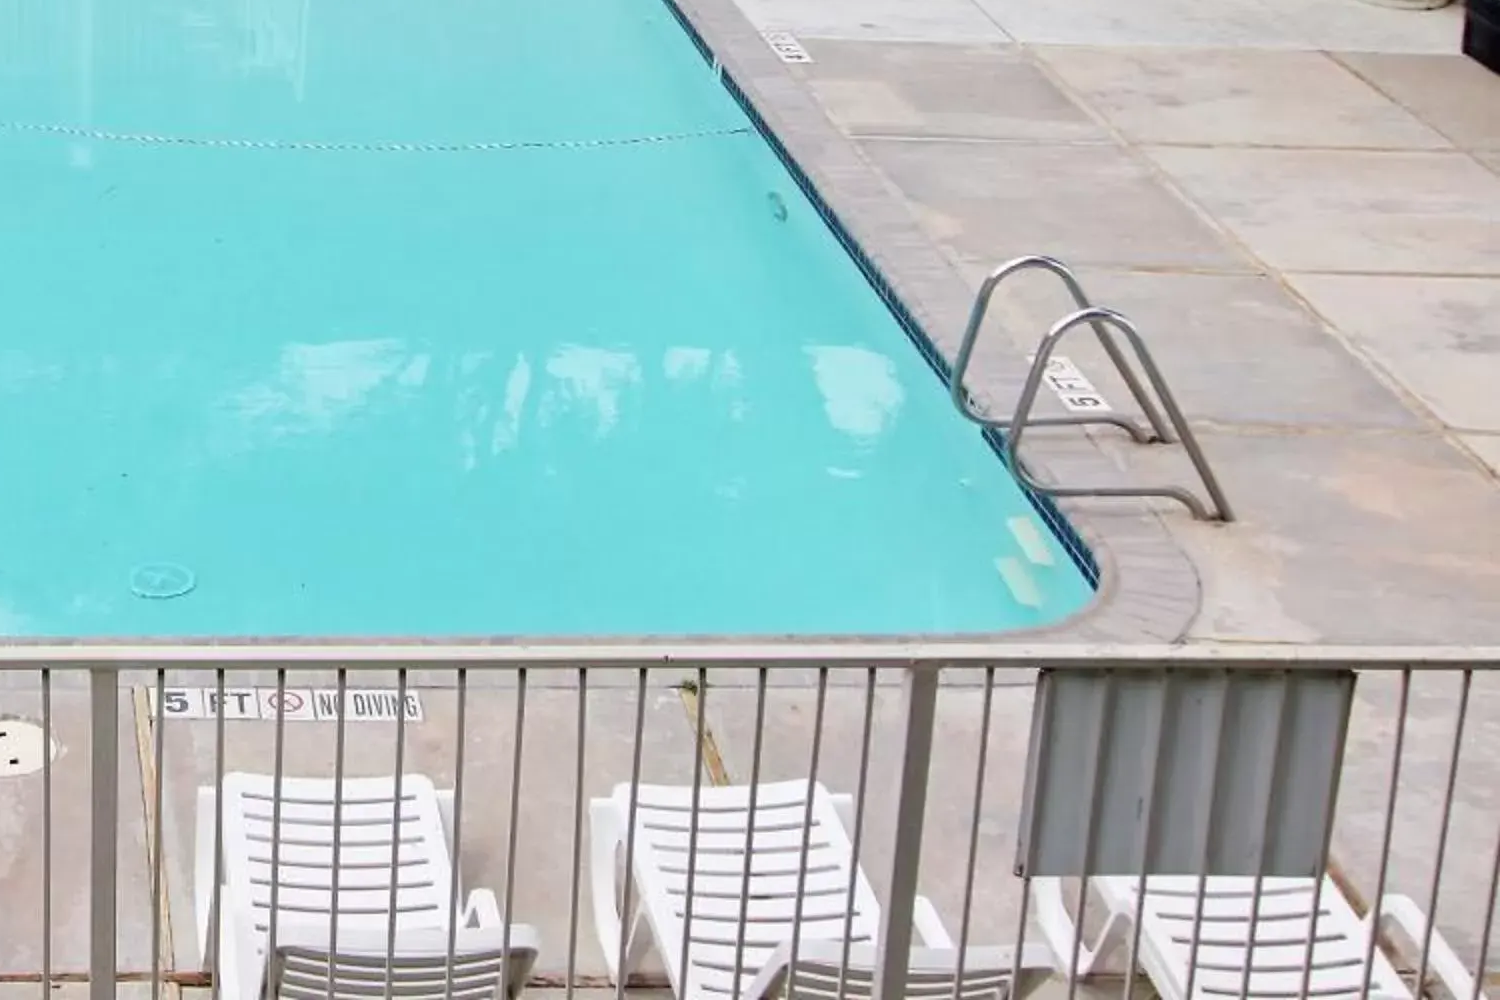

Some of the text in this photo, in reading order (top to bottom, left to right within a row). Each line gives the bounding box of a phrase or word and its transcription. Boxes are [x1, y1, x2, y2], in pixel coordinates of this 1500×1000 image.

[1068, 396, 1101, 407] 5
[165, 691, 189, 713] 5
[209, 692, 252, 714] FT
[353, 693, 418, 717] DIVING
